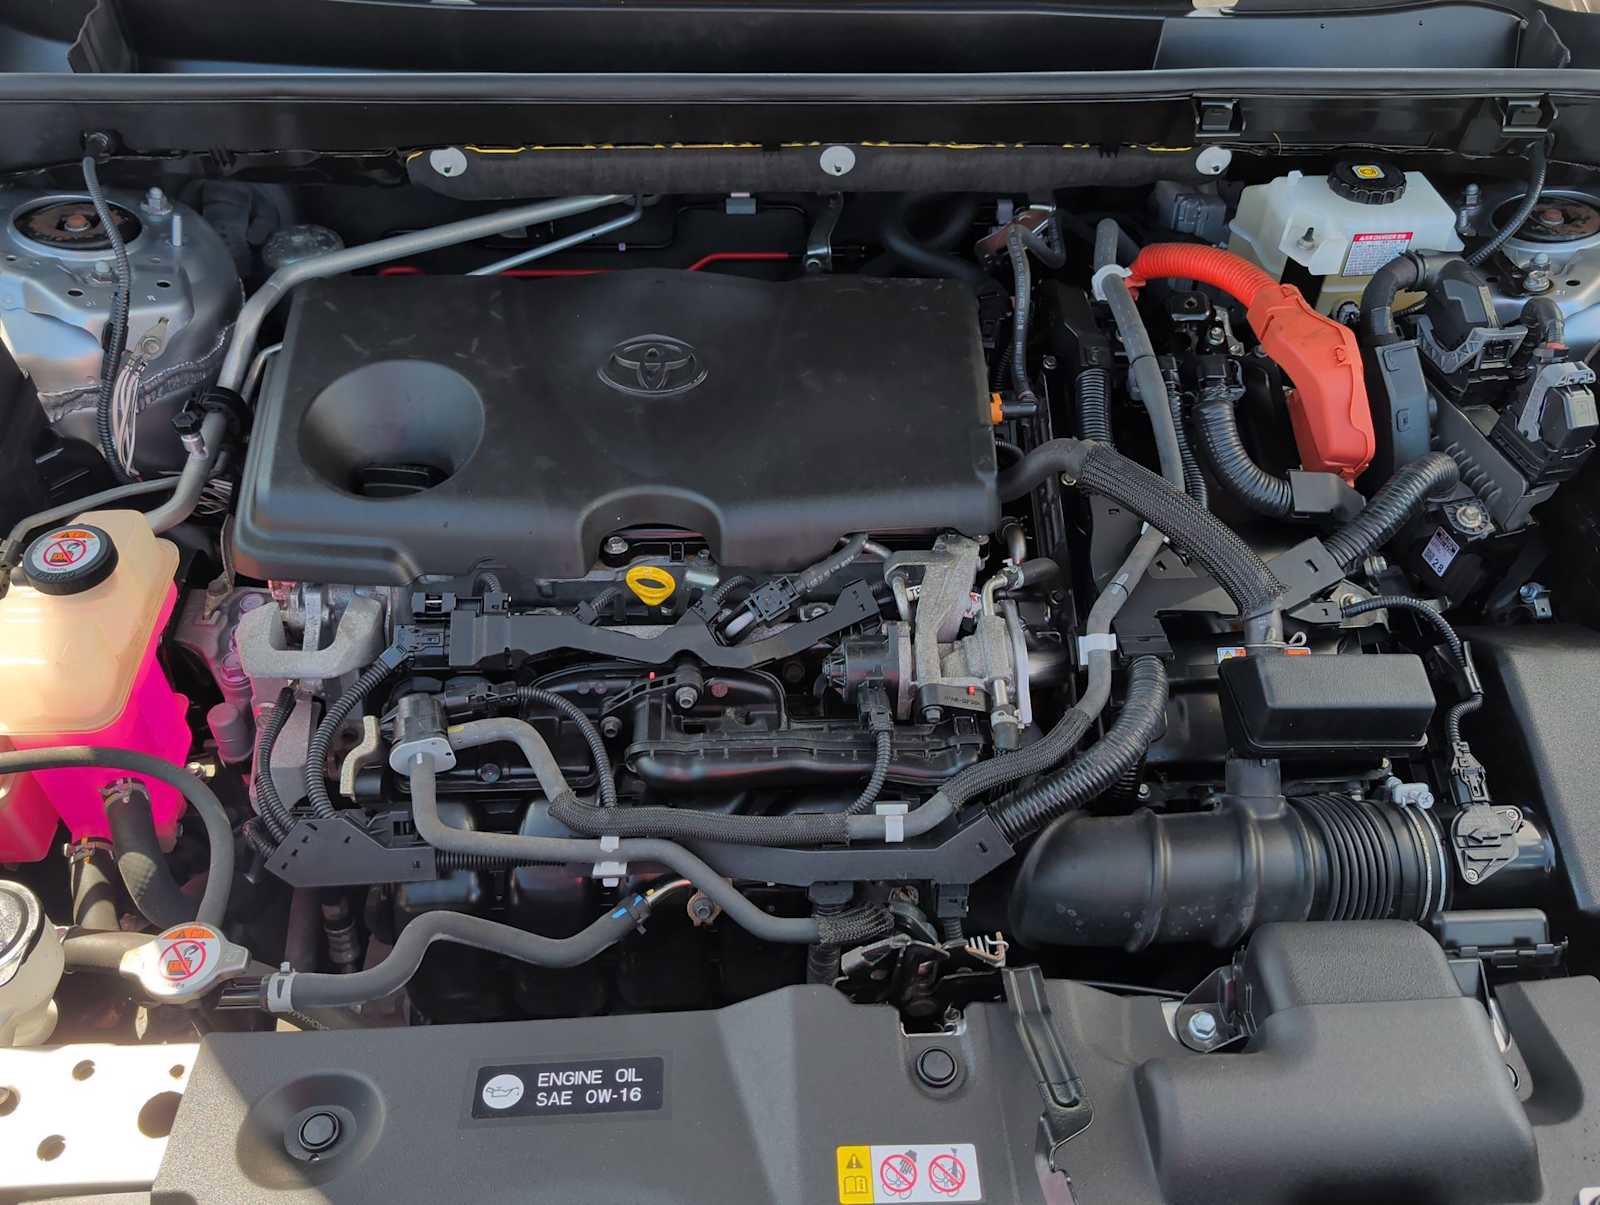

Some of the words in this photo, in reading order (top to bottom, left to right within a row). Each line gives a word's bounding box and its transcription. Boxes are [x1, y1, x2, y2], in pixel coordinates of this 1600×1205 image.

[537, 1070, 603, 1087] ENGINE
[615, 1068, 643, 1083] OIL
[536, 1091, 573, 1106] SAE
[585, 1087, 642, 1104] 0W-16
